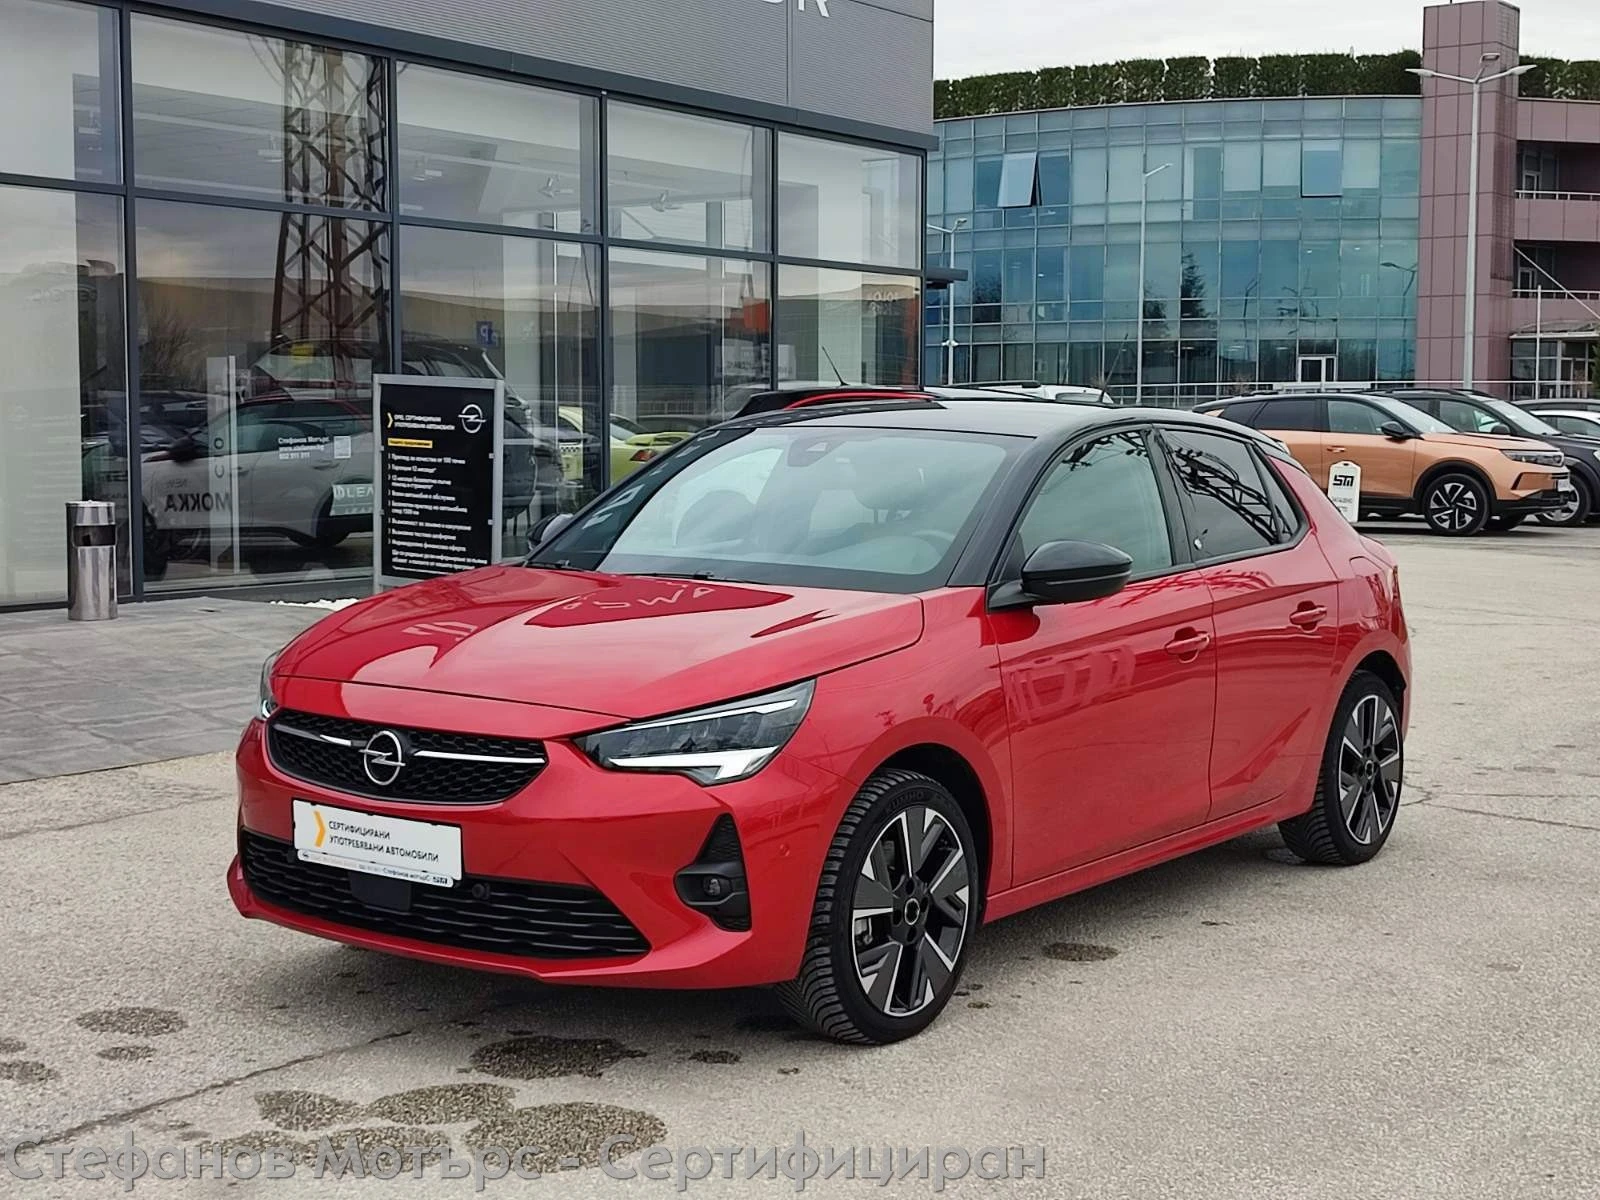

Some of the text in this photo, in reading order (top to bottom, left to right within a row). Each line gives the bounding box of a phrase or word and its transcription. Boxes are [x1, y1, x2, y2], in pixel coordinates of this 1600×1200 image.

[328, 820, 391, 840] СЕРТИФИЦИРАНИ
[329, 835, 440, 862] УПОТРЕБЯВАНИ АВТОМОБИЛИ
